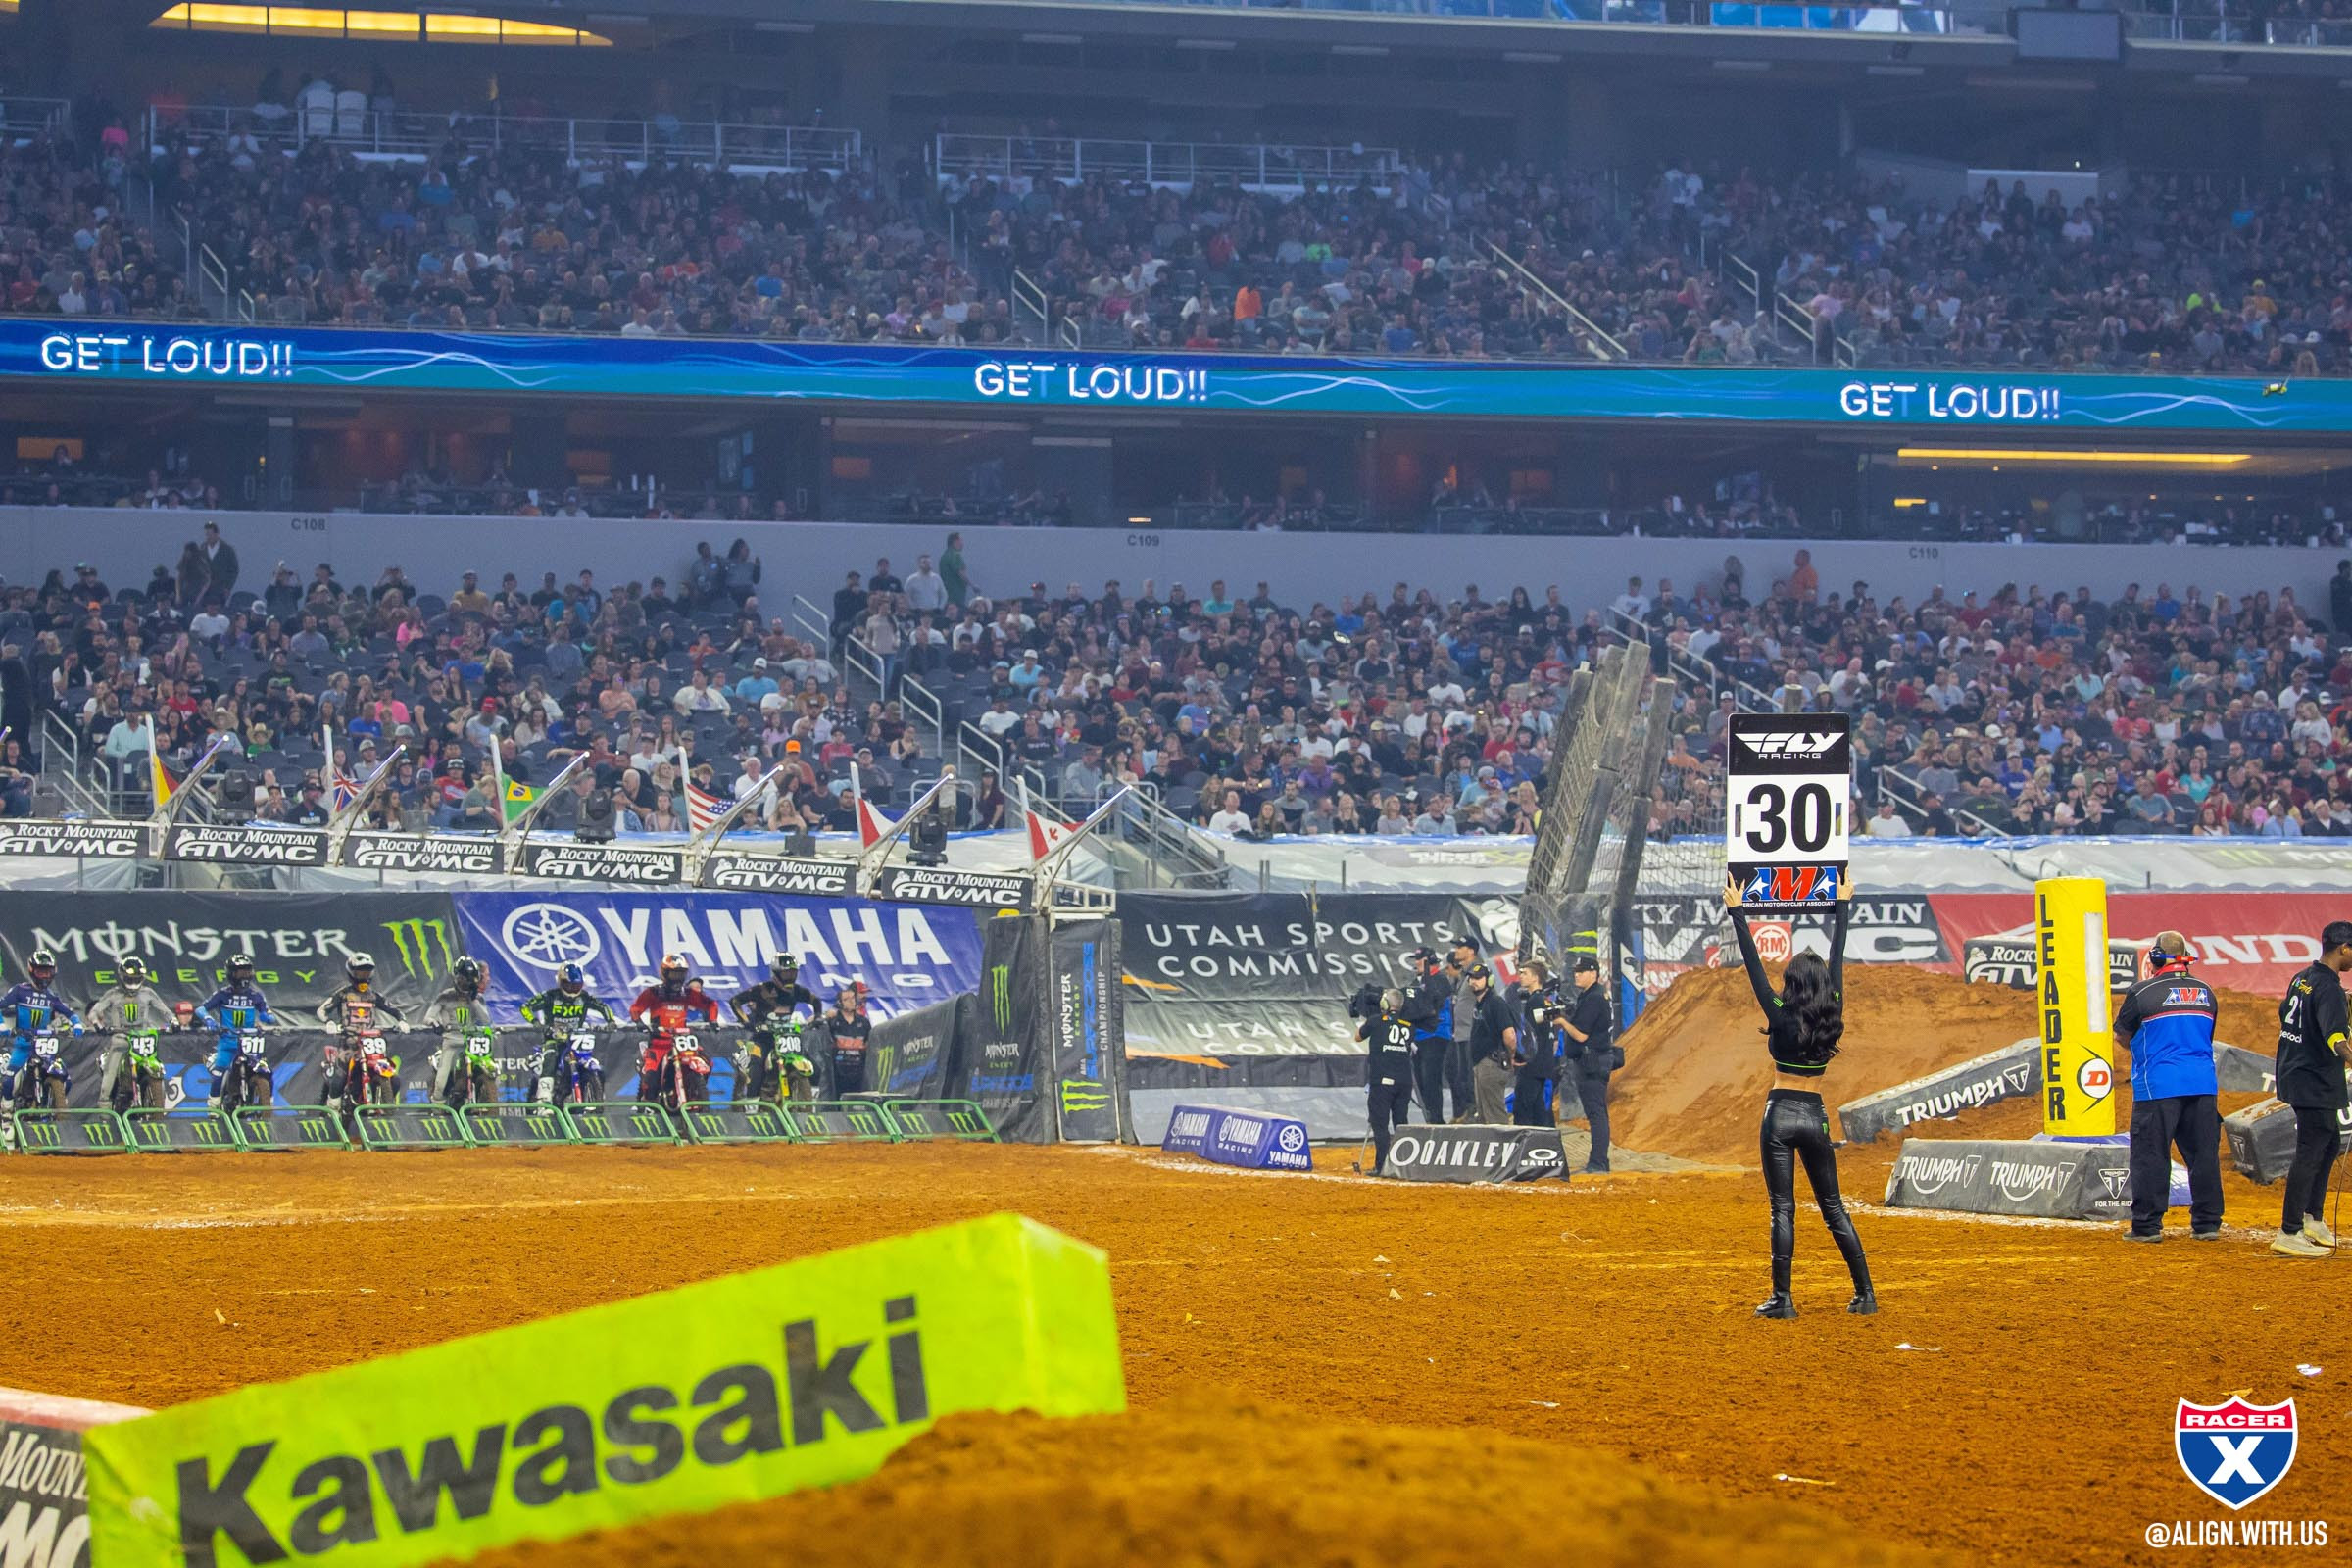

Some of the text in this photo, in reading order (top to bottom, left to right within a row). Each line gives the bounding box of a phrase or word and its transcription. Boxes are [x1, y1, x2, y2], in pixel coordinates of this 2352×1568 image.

[41, 334, 292, 376] GET LOUD!!
[974, 362, 1207, 400] GET LOUD!!
[1840, 382, 2059, 419] GET LOUD!!
[290, 518, 326, 531] C108
[1127, 534, 1160, 547] C109
[1910, 548, 1939, 559] C110
[1735, 733, 1845, 753] FLY
[1746, 783, 1832, 854] 30
[18, 823, 138, 840] ROCKY MOUNTAIN
[198, 828, 318, 845] ROCKY MOUNTAIN
[376, 838, 494, 856] ROCKY MOUNTAIN
[558, 848, 673, 864] ROCKY MOUNTAIN
[735, 858, 847, 877] ROCKY MOUNTAIN
[912, 870, 1022, 890] ROCKY MOUNTAIN
[1742, 866, 1838, 902] AMA
[31, 919, 355, 963] MONSTER
[598, 907, 952, 967] YAMAHA
[1145, 921, 1455, 948] UTAH SPORTS
[1157, 952, 1421, 977] COMMISSIO
[584, 972, 933, 989] ACNG
[2163, 988, 2209, 1004] AMA
[1060, 972, 1073, 1048] MONSTER
[1098, 971, 1109, 1051] CHAMPIONSHIP
[2039, 894, 2066, 1121] LEADER
[1187, 1021, 1308, 1039] UTAH
[35, 1037, 59, 1054] 59
[132, 1037, 155, 1055] 43
[241, 1037, 266, 1054] 511
[362, 1038, 387, 1054] 39
[468, 1037, 490, 1054] 63
[570, 1034, 596, 1051] 75
[674, 1035, 699, 1052] 60
[2084, 1069, 2109, 1087] D
[1896, 1076, 2005, 1126] TRIUMPH
[1179, 1113, 1211, 1138] YAMAHA
[1227, 1117, 1263, 1146] YAMAHA
[1171, 1138, 1202, 1147] RACING
[1217, 1143, 1254, 1154] RACING
[1269, 1150, 1308, 1166] YAMAHA
[1419, 1140, 1519, 1168] OAKLEY
[1902, 1156, 1965, 1193] TRIUMPH
[1991, 1161, 2056, 1200] TRIUMPH
[175, 1295, 932, 1568] Kawasaki
